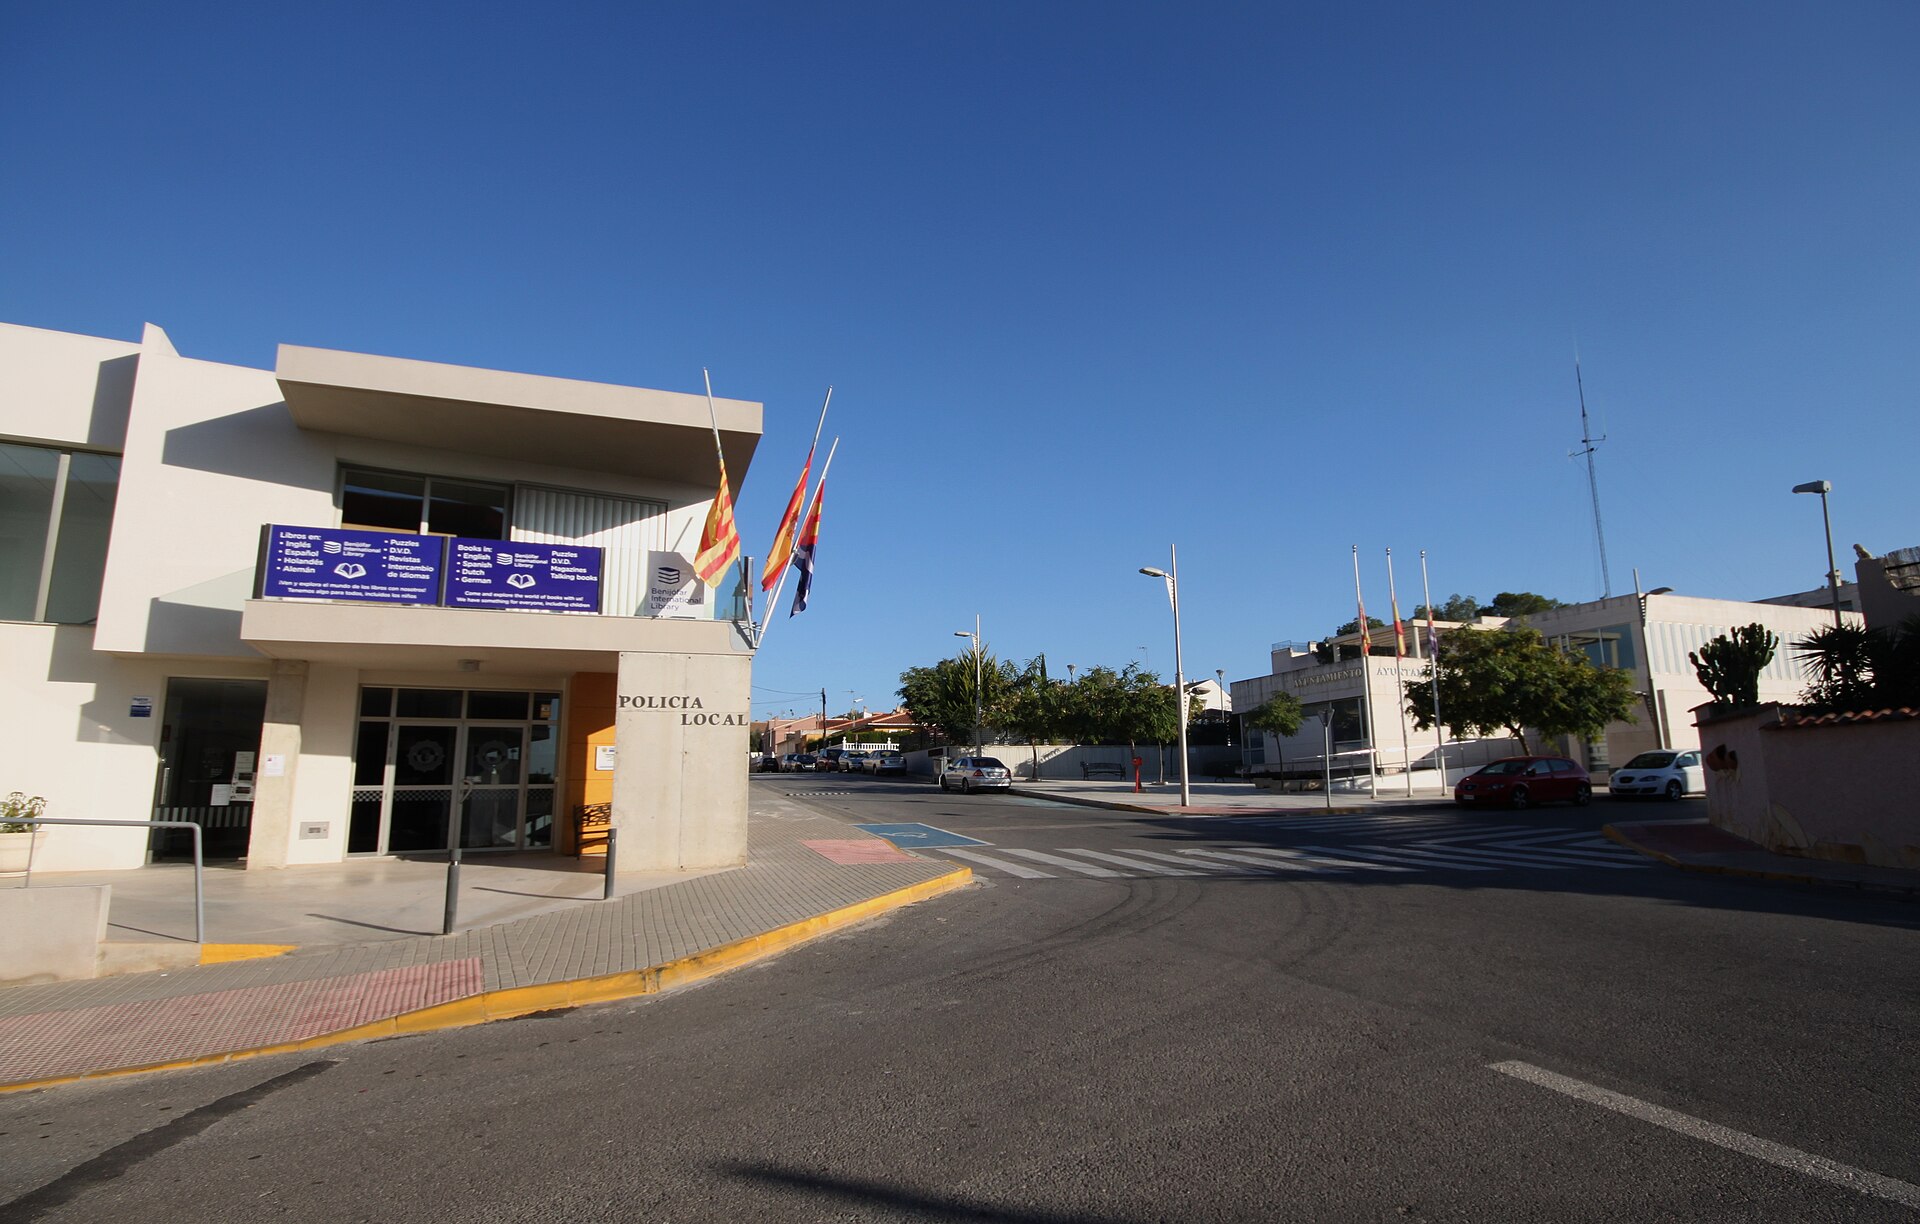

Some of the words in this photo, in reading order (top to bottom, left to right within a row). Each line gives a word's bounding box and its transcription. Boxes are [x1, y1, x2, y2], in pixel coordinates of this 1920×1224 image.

[286, 540, 311, 548] Inglés
[390, 539, 419, 547] Puzzles
[458, 544, 481, 552] Books
[285, 549, 319, 557] Español
[551, 550, 578, 558] Puzzles
[284, 557, 324, 565] Holandés
[388, 555, 420, 563] Revistas
[388, 564, 434, 572] Intercambio
[462, 560, 492, 568] Spanish
[462, 568, 485, 576] Dutch
[550, 565, 587, 573] Magazines
[461, 576, 492, 584] German
[550, 573, 575, 581] Talking
[651, 595, 702, 604] International
[651, 603, 680, 611] Library
[1294, 667, 1362, 688] AYUNTAMIENTO
[680, 714, 748, 726] LOCAL
